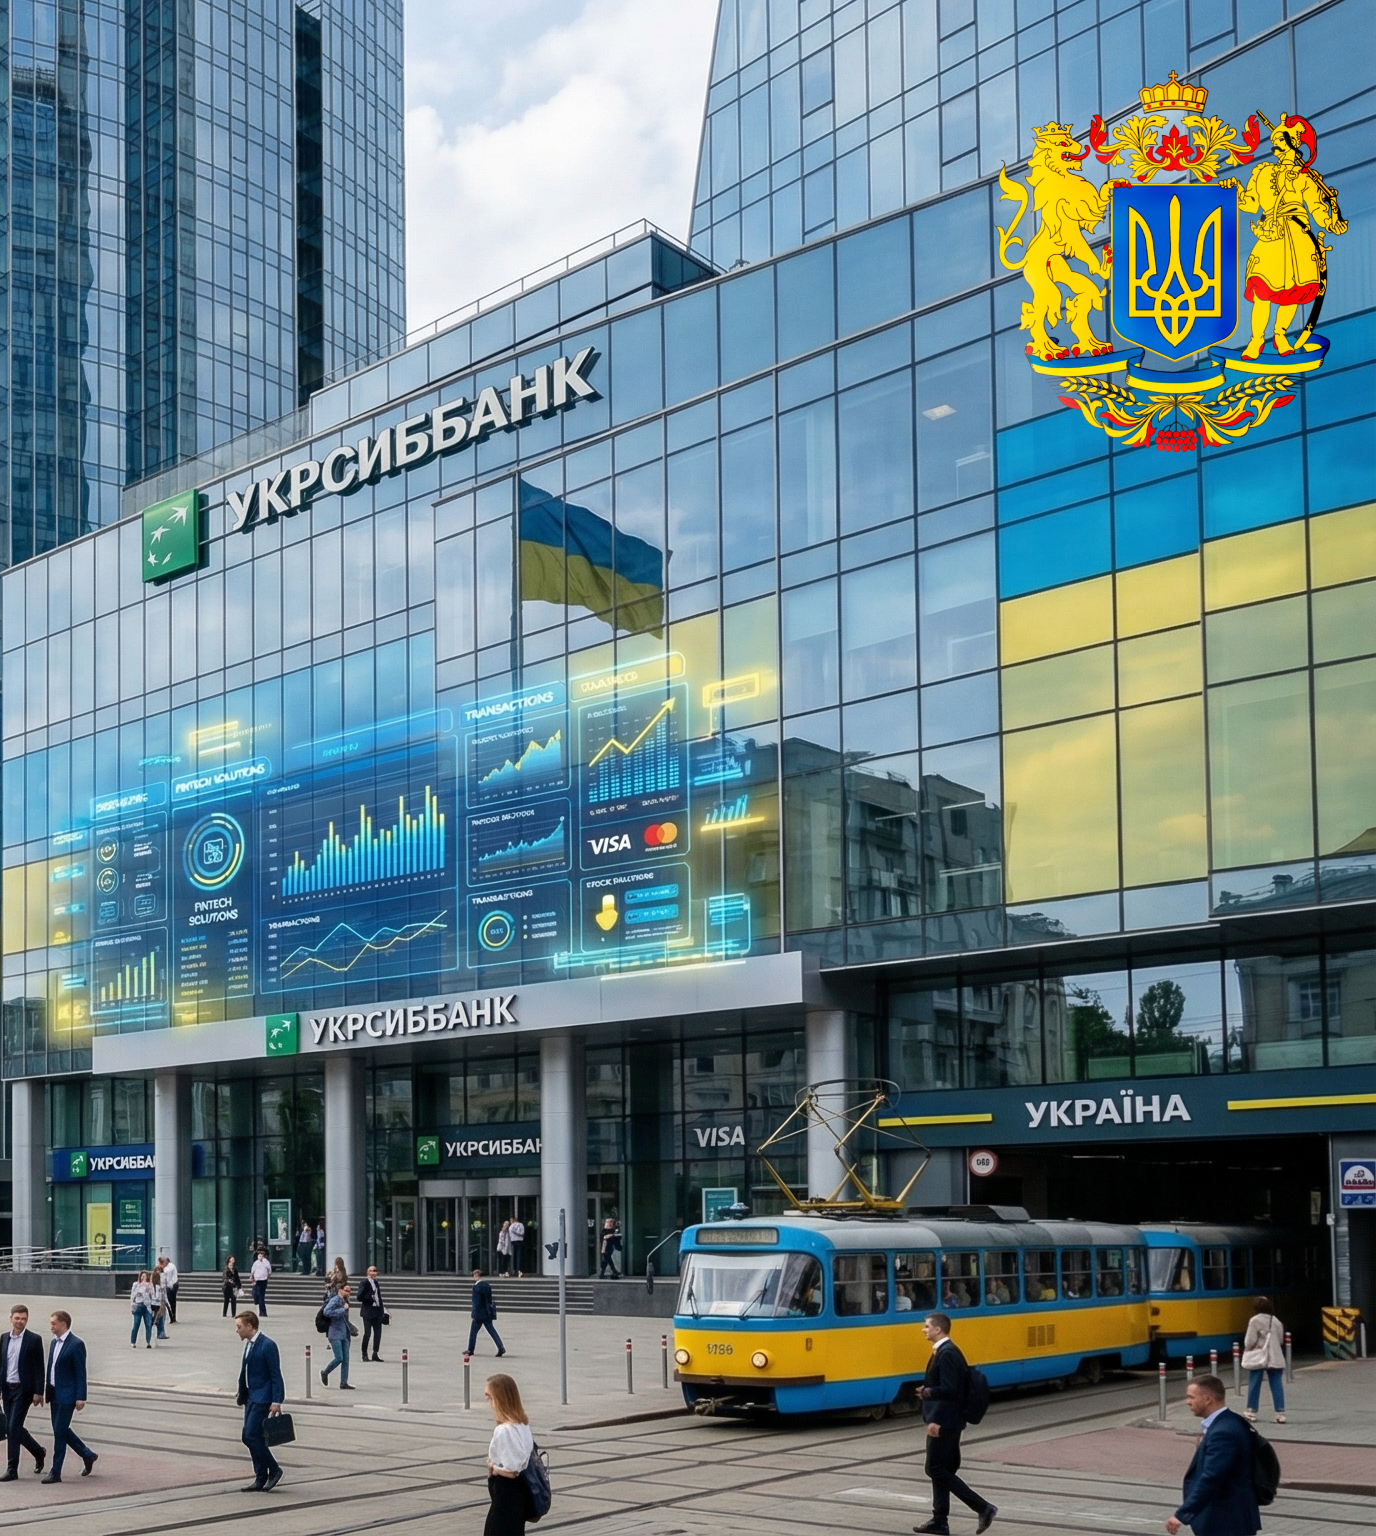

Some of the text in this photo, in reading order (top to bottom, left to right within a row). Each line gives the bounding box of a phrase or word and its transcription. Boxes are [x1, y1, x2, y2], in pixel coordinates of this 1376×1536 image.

[225, 345, 600, 532] УКРСИББАНК
[587, 833, 632, 855] VISA
[309, 993, 520, 1045] УКРСИББАНК
[1024, 1089, 1192, 1129] УКРАЇНА
[693, 1126, 745, 1147] VISA
[89, 1154, 155, 1171] УКРСИББА
